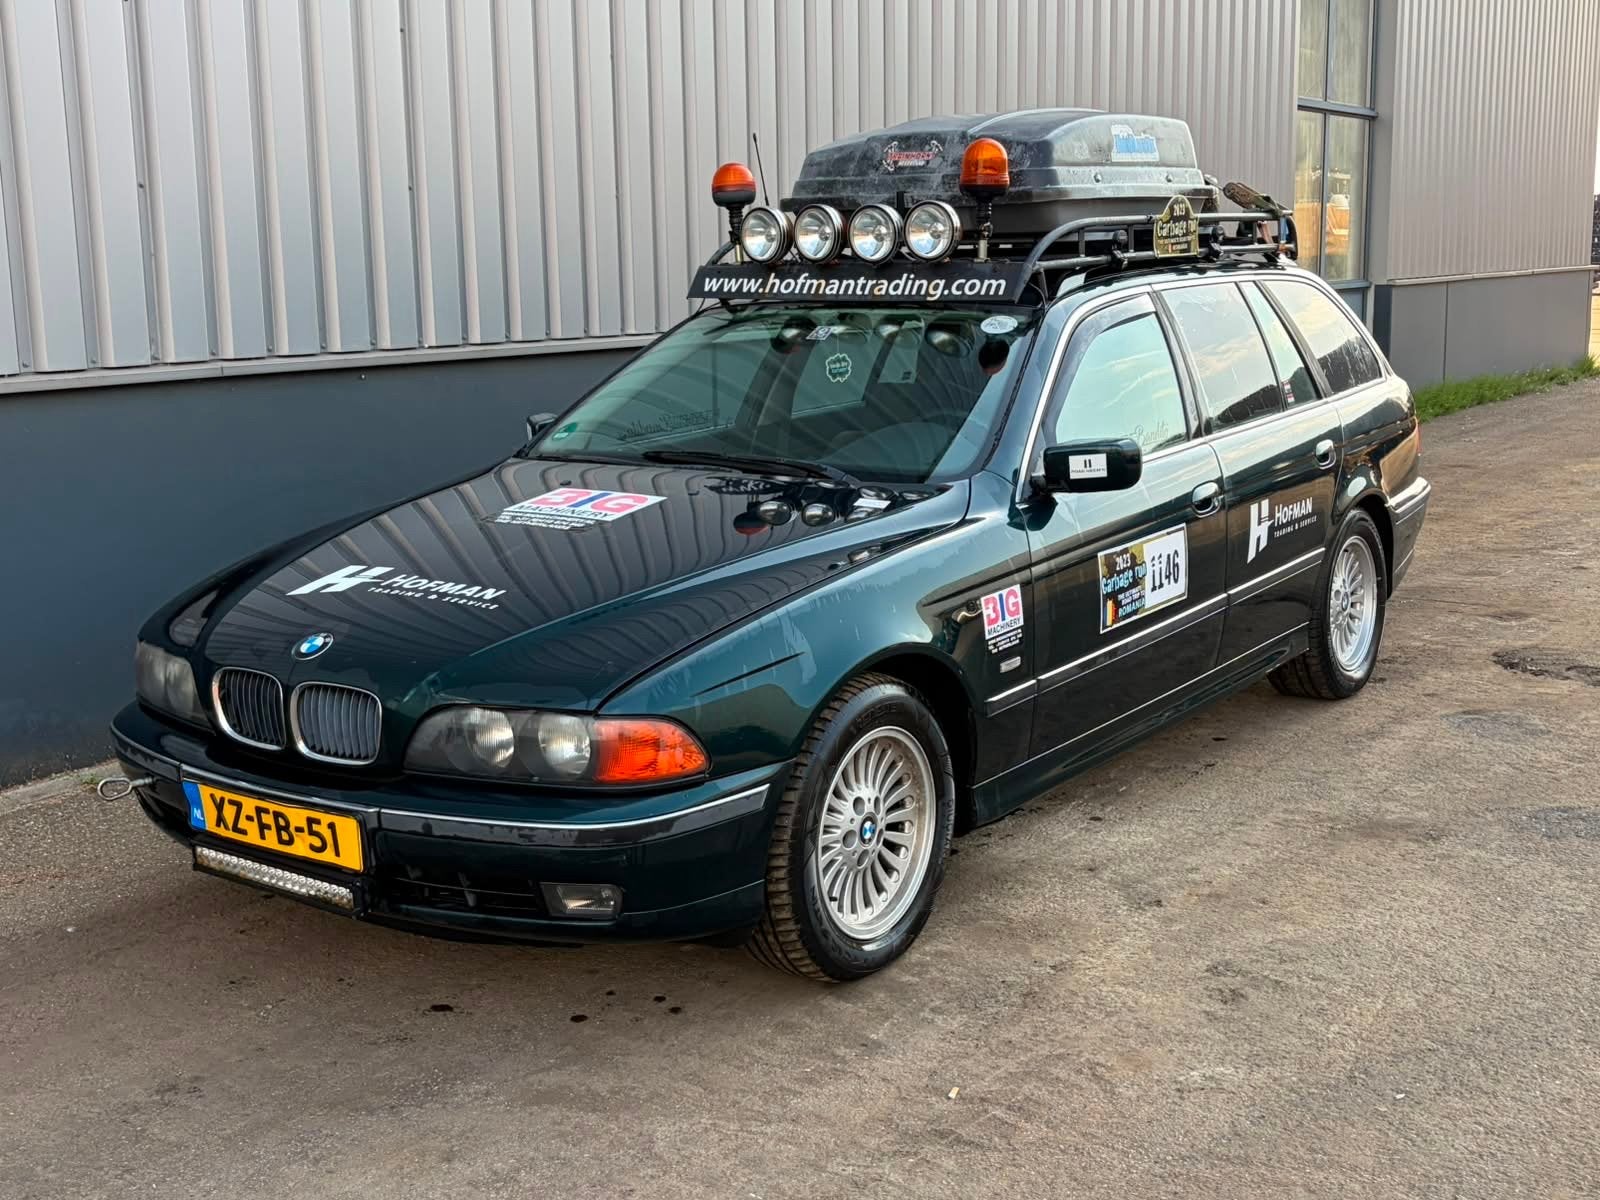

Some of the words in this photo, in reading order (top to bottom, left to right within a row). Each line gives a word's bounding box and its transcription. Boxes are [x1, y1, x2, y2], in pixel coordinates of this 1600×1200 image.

[703, 272, 1007, 300] www.hofmantrading.com
[513, 504, 615, 519] MACHINERY
[1300, 515, 1317, 528] SERVICE
[1115, 552, 1131, 571] 2023
[1150, 549, 1180, 593] 1146
[379, 574, 507, 600] HOFMAN
[1101, 569, 1133, 595] Garbage
[1134, 561, 1148, 579] run
[367, 587, 425, 598] TRADING
[441, 595, 500, 610] SERVICE
[1118, 598, 1146, 618] ROMANIA
[987, 617, 1021, 637] MACHINERY
[193, 807, 204, 821] NL
[210, 793, 341, 858] XZ-FB-51
